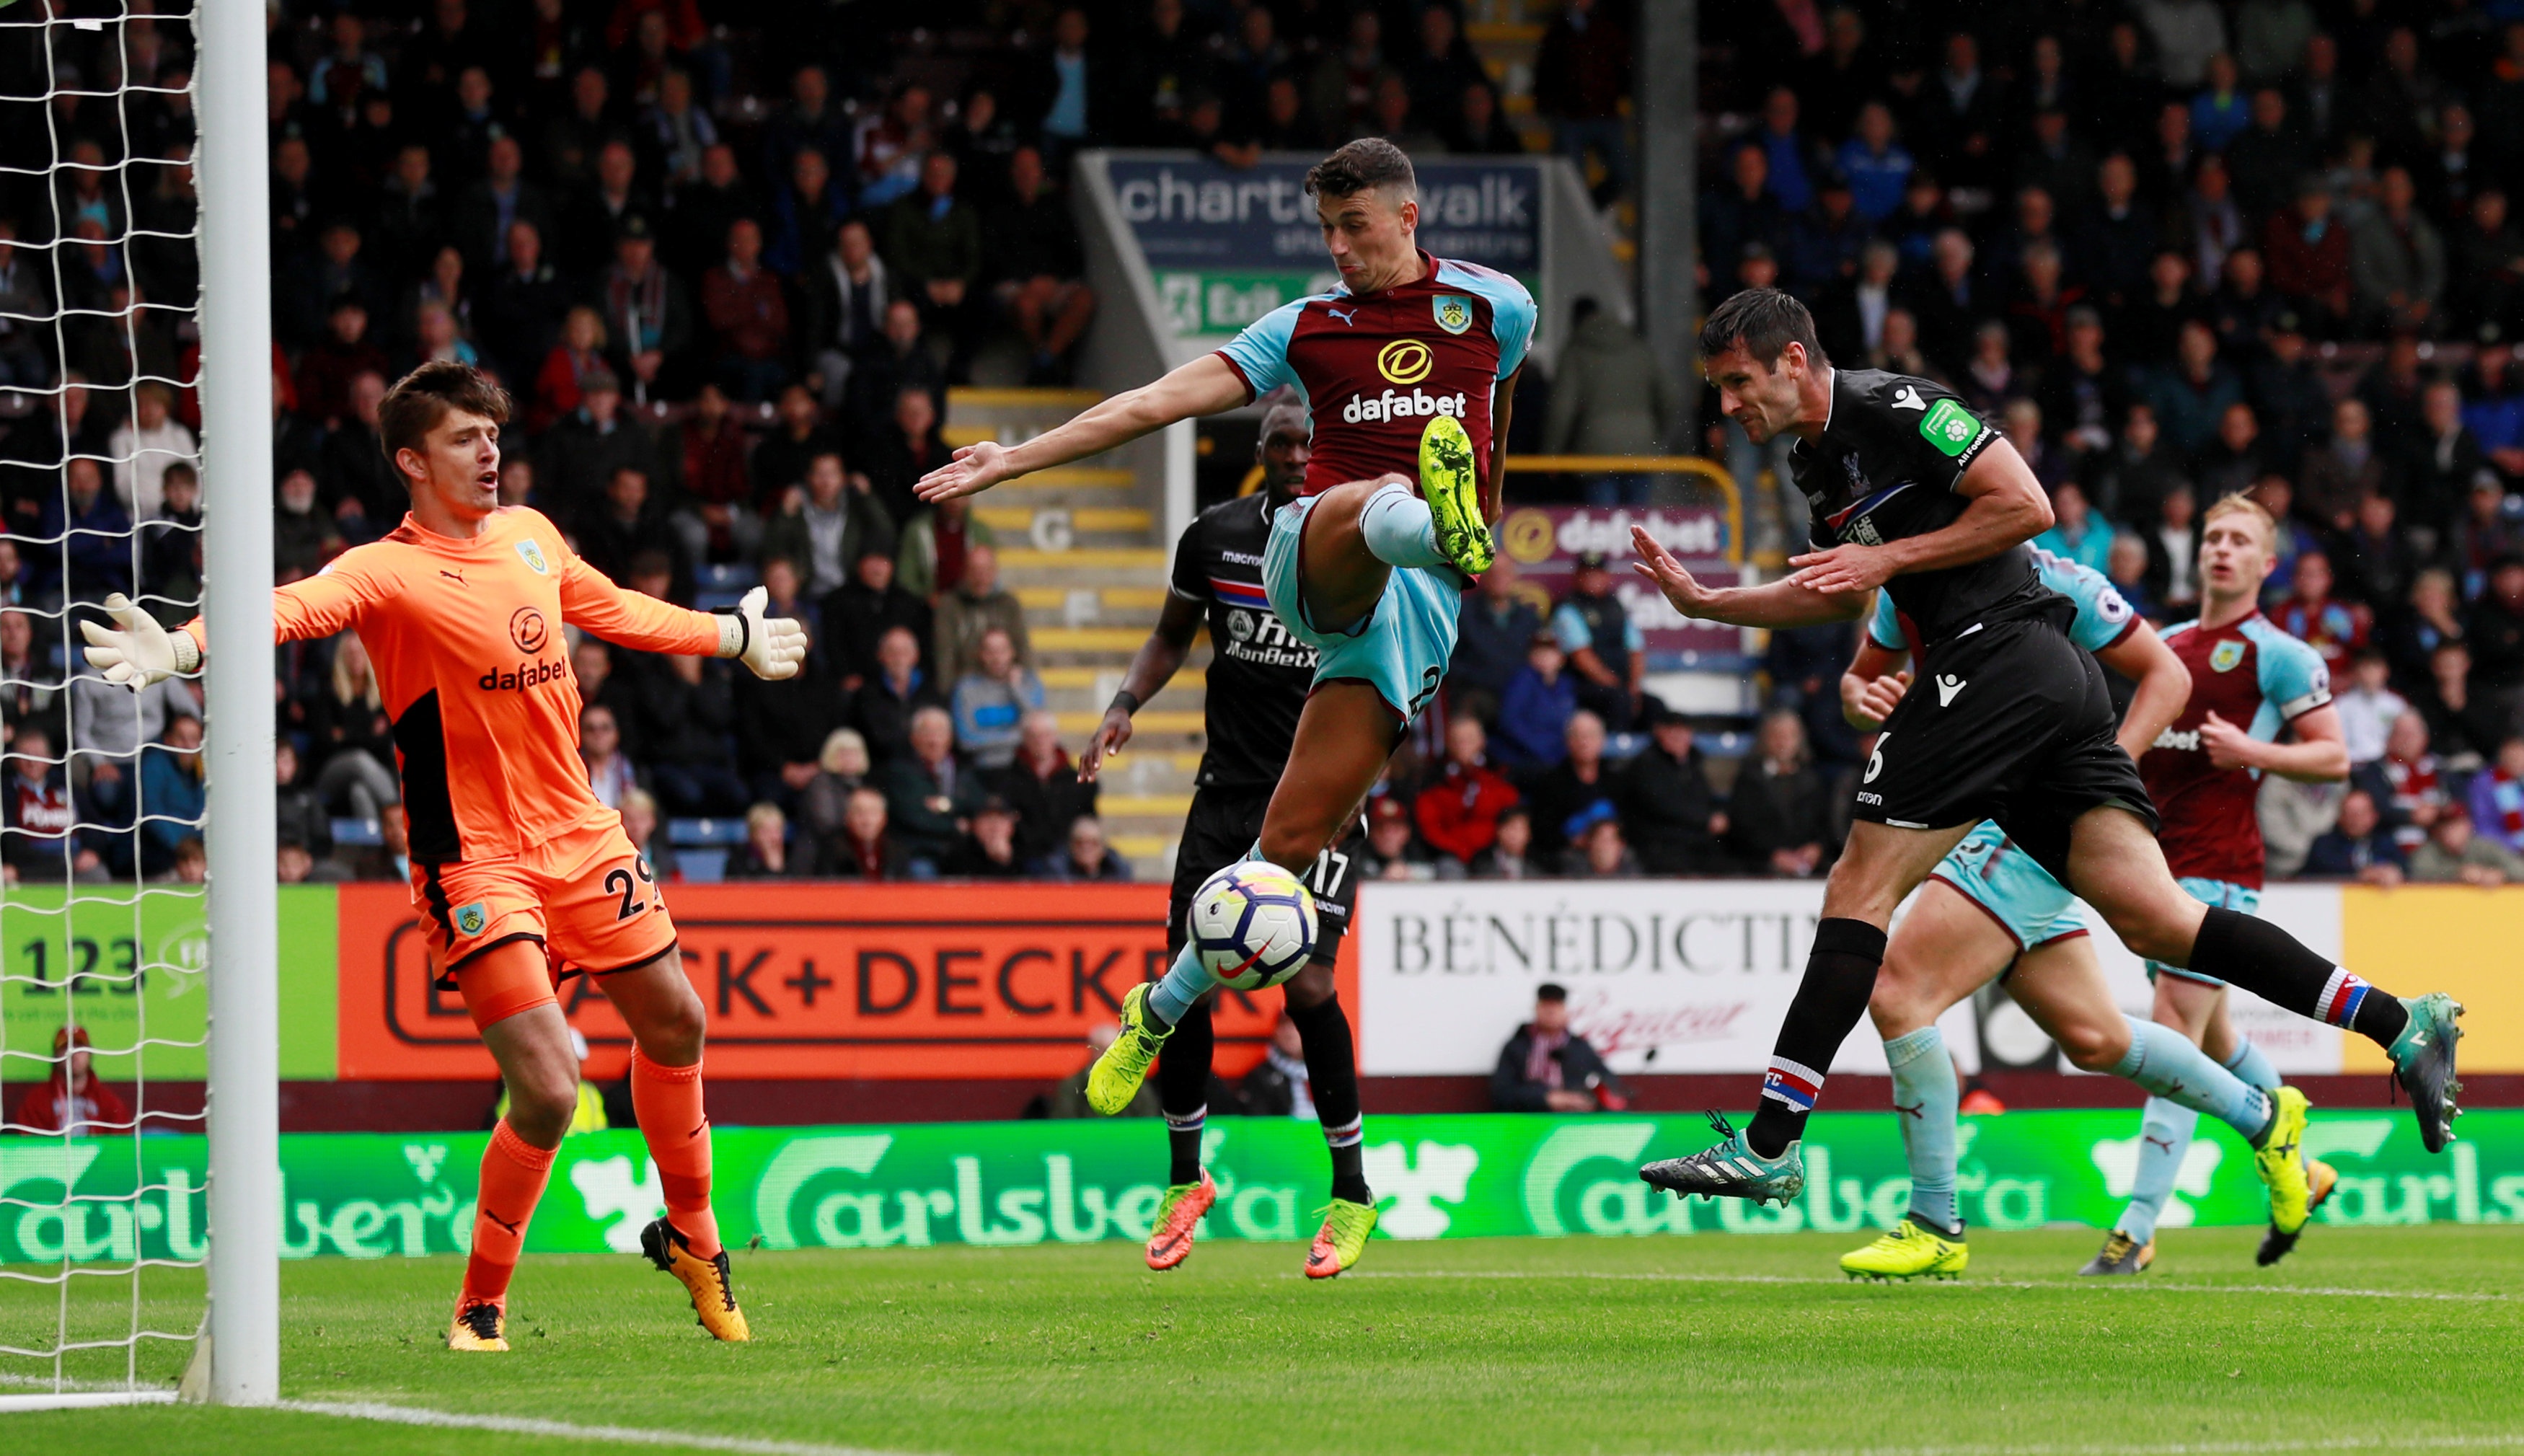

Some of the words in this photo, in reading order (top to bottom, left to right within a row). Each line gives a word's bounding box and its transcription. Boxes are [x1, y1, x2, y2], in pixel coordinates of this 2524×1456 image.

[1343, 387, 1467, 424] dafabet
[1958, 453, 1970, 467] All
[478, 655, 568, 694] dafabet
[1313, 848, 1349, 899] 17
[1392, 896, 1819, 975] BÉNÉDICTI
[22, 936, 146, 998] 123
